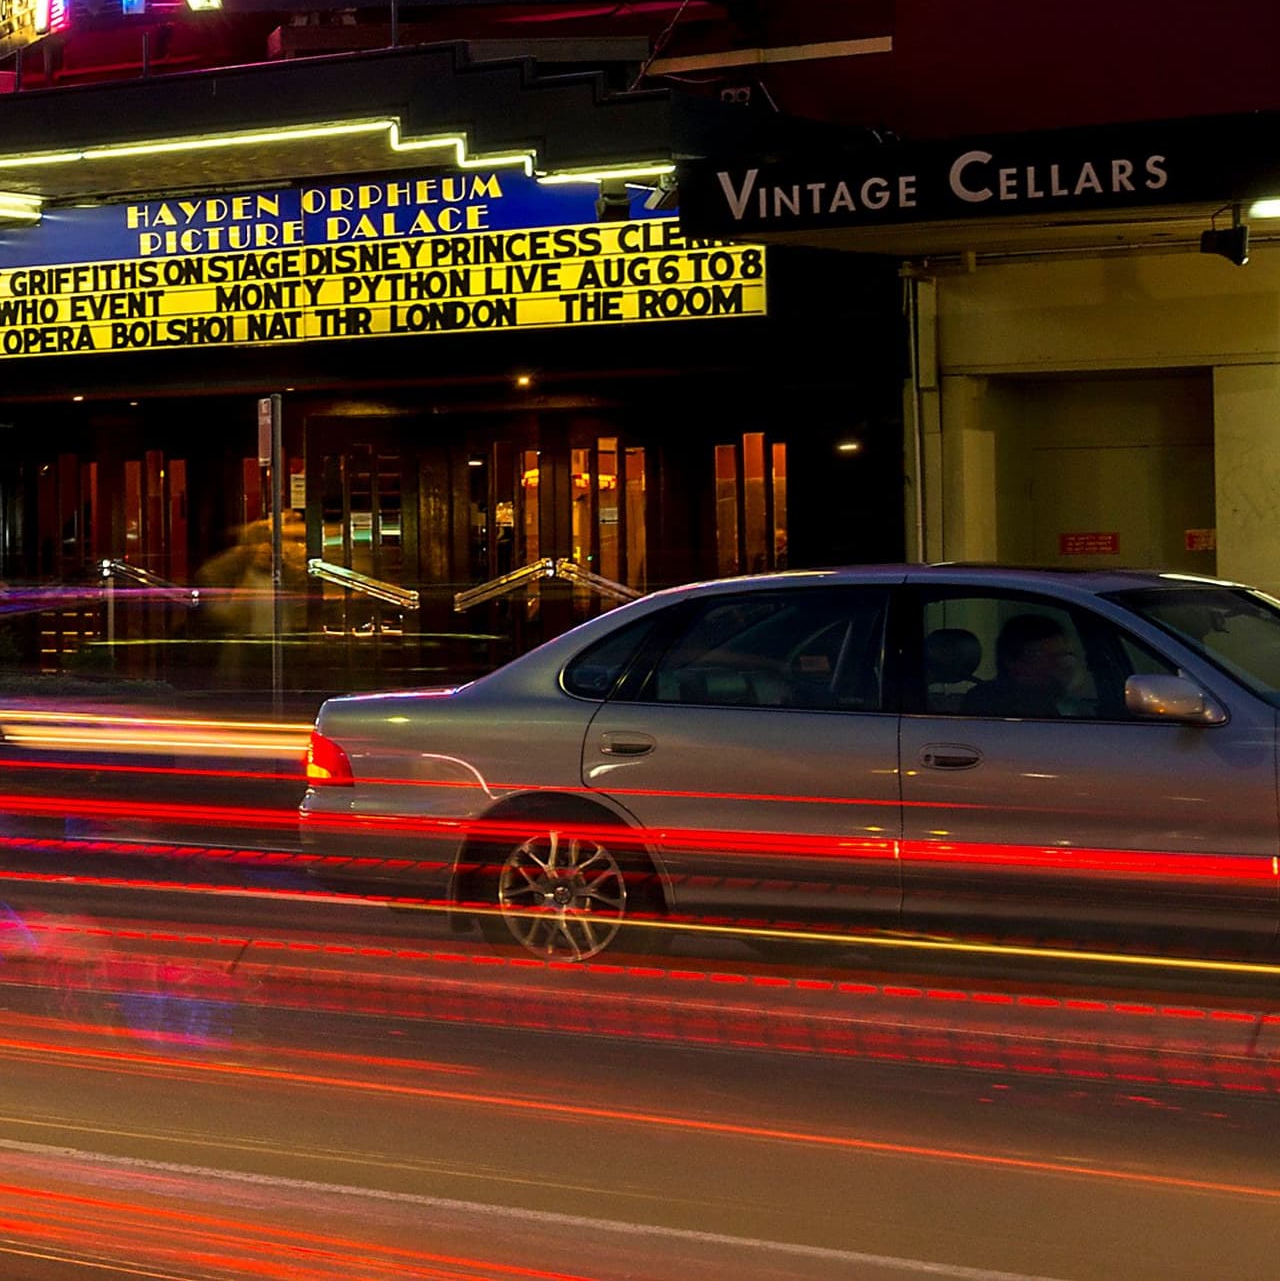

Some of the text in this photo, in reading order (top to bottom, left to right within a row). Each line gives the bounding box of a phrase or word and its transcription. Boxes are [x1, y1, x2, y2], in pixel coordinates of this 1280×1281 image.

[127, 174, 503, 230] HAYDEN ORPHEUM
[139, 205, 489, 256] PICTURE PALACE
[10, 261, 158, 297] GRIFFITHS
[164, 257, 204, 285] ON
[208, 250, 300, 283] STAGE
[301, 240, 423, 276] DISNEY
[431, 227, 602, 267] PRINCESS
[70, 290, 164, 321] EVENT
[215, 278, 323, 313] MONTY
[343, 265, 471, 304] PYTHON
[485, 262, 561, 296] LIVE
[577, 257, 650, 289] AUG
[658, 255, 679, 284] 6
[691, 250, 735, 282] TO
[740, 248, 763, 279] 8
[3, 323, 95, 355] OPERA
[111, 315, 235, 348] BOLSHOI
[247, 311, 302, 341] NAT
[315, 305, 372, 337] THR
[390, 298, 517, 332] LONDON
[560, 292, 624, 323] THE
[638, 284, 741, 318] ROOM
